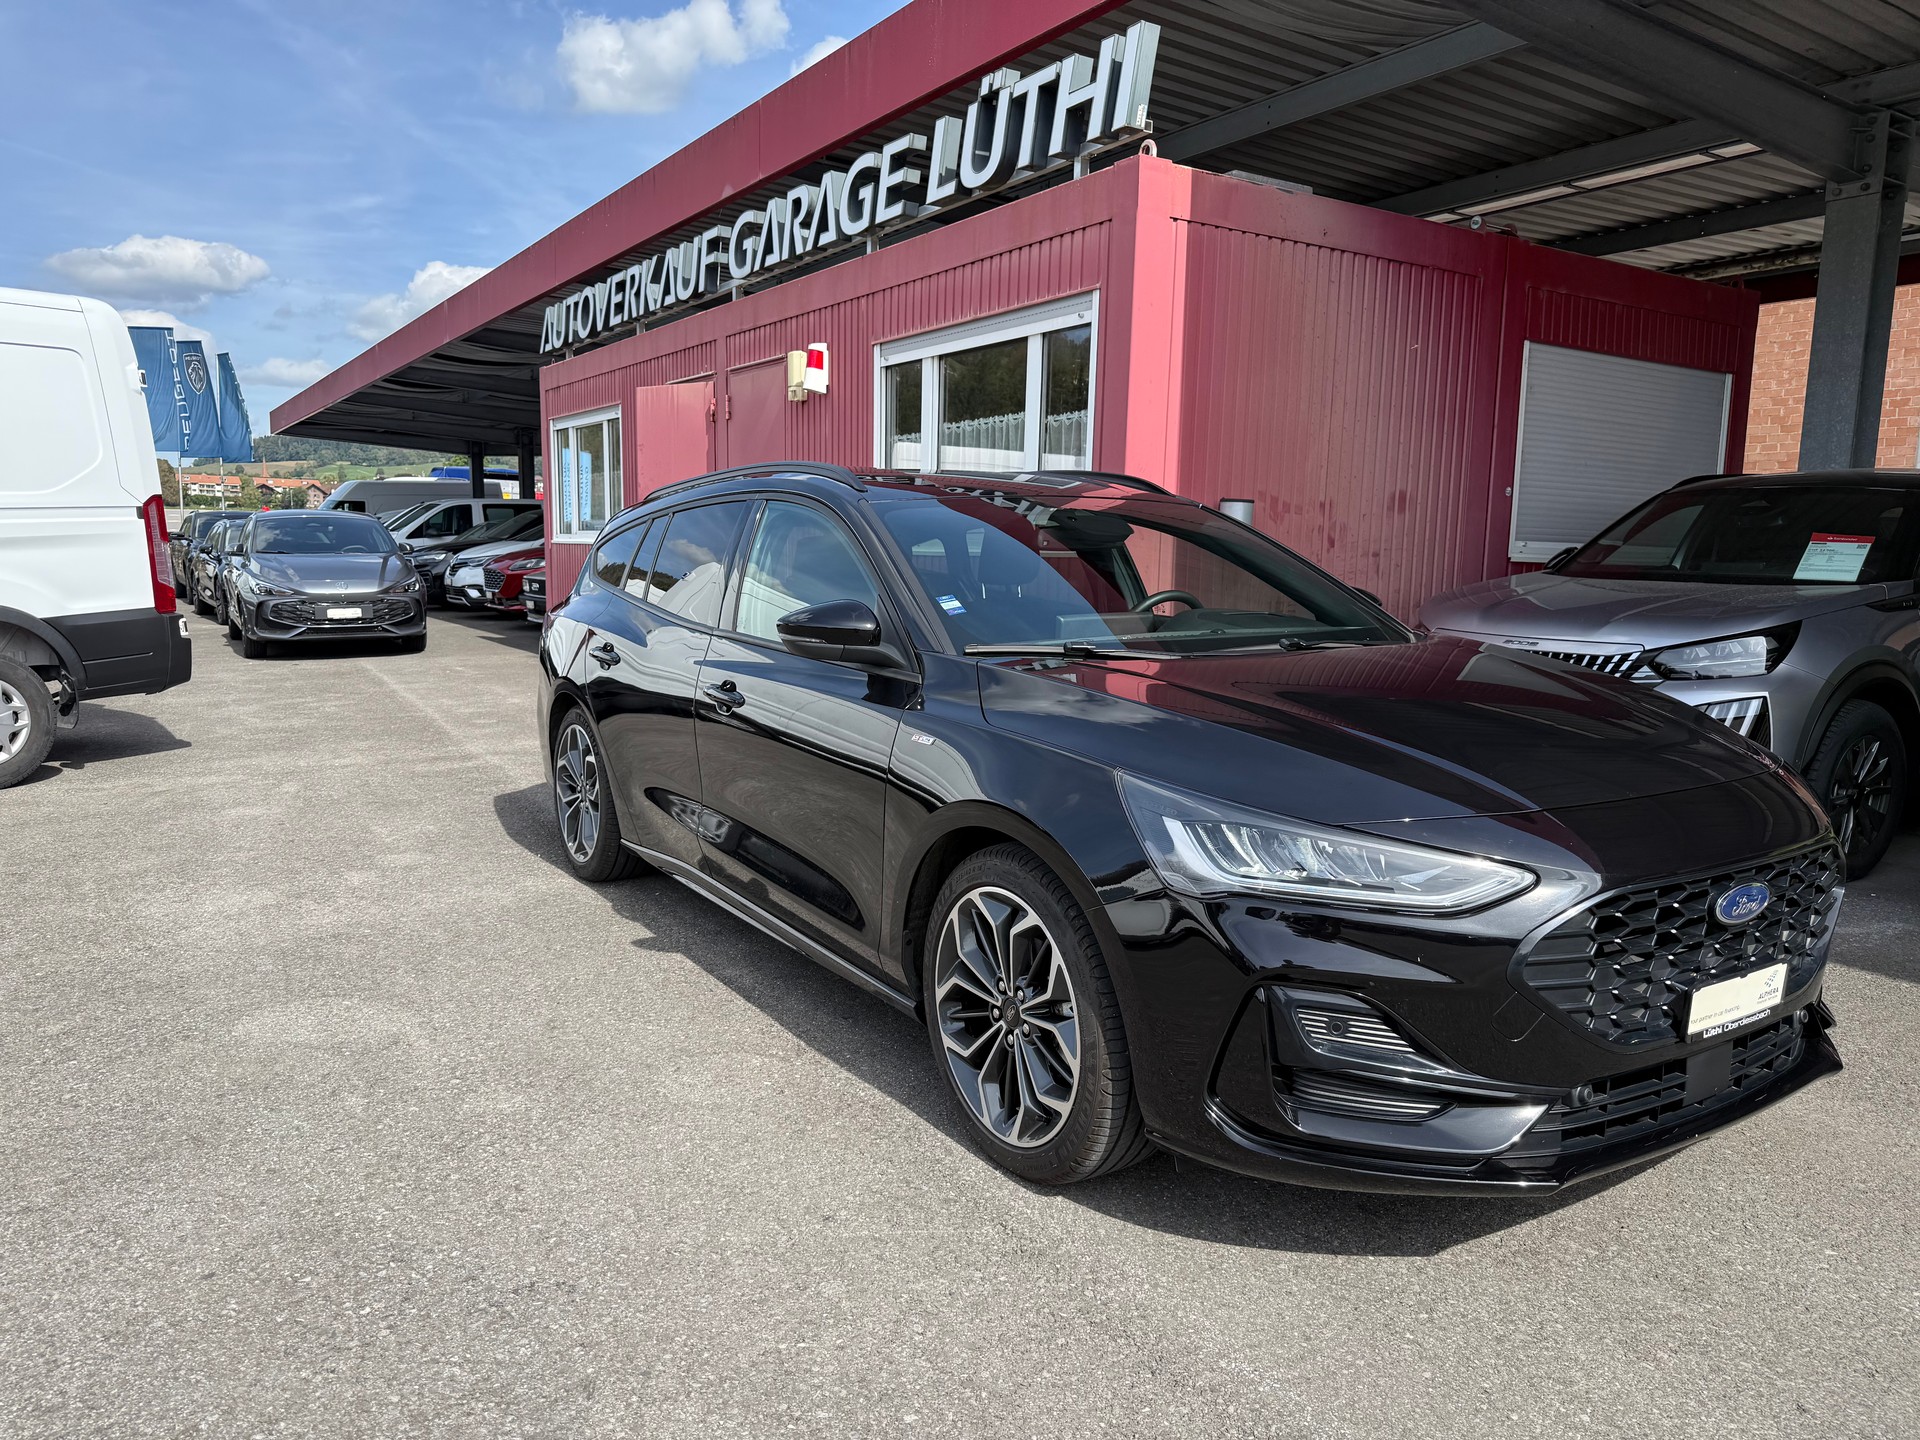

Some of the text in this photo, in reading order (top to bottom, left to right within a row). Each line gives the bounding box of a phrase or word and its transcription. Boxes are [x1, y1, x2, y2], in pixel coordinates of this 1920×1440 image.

[540, 19, 1161, 354] AUTOVERKAUF GARAGE LÜTHI
[1731, 888, 1763, 916] Ford
